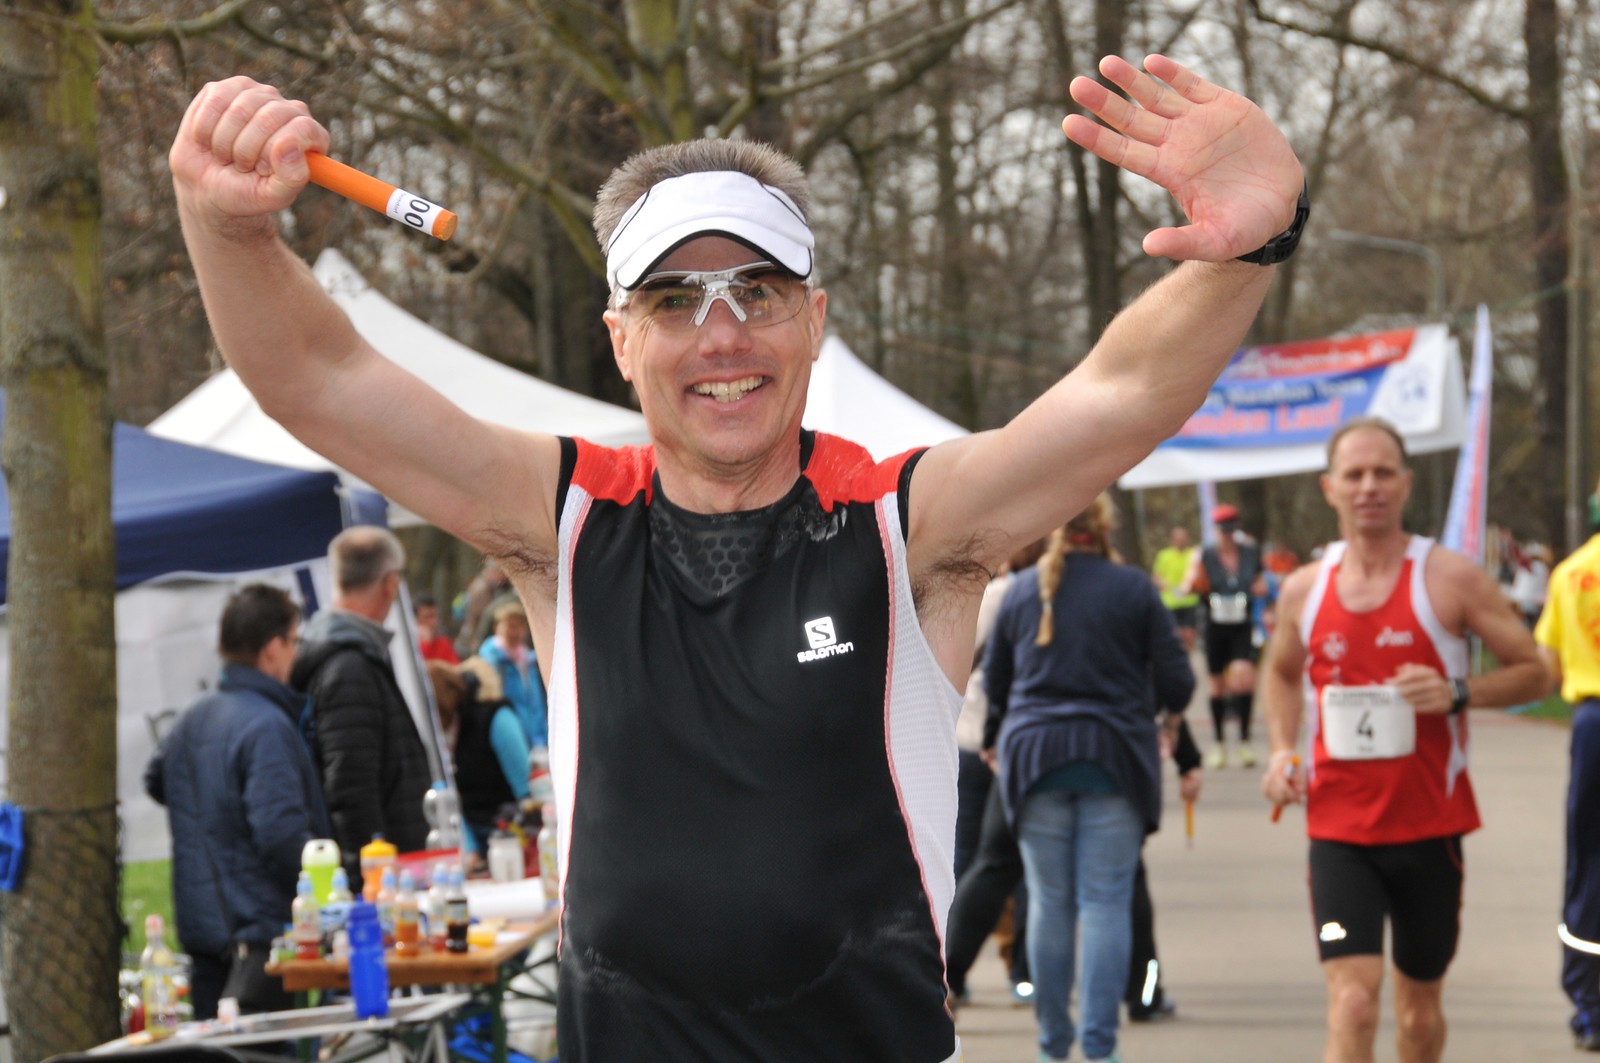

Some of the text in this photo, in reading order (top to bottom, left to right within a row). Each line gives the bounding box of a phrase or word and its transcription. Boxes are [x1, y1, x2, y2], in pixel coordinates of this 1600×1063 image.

[405, 199, 431, 228] 00
[1276, 396, 1342, 432] Lauf
[1357, 710, 1374, 739] 4
